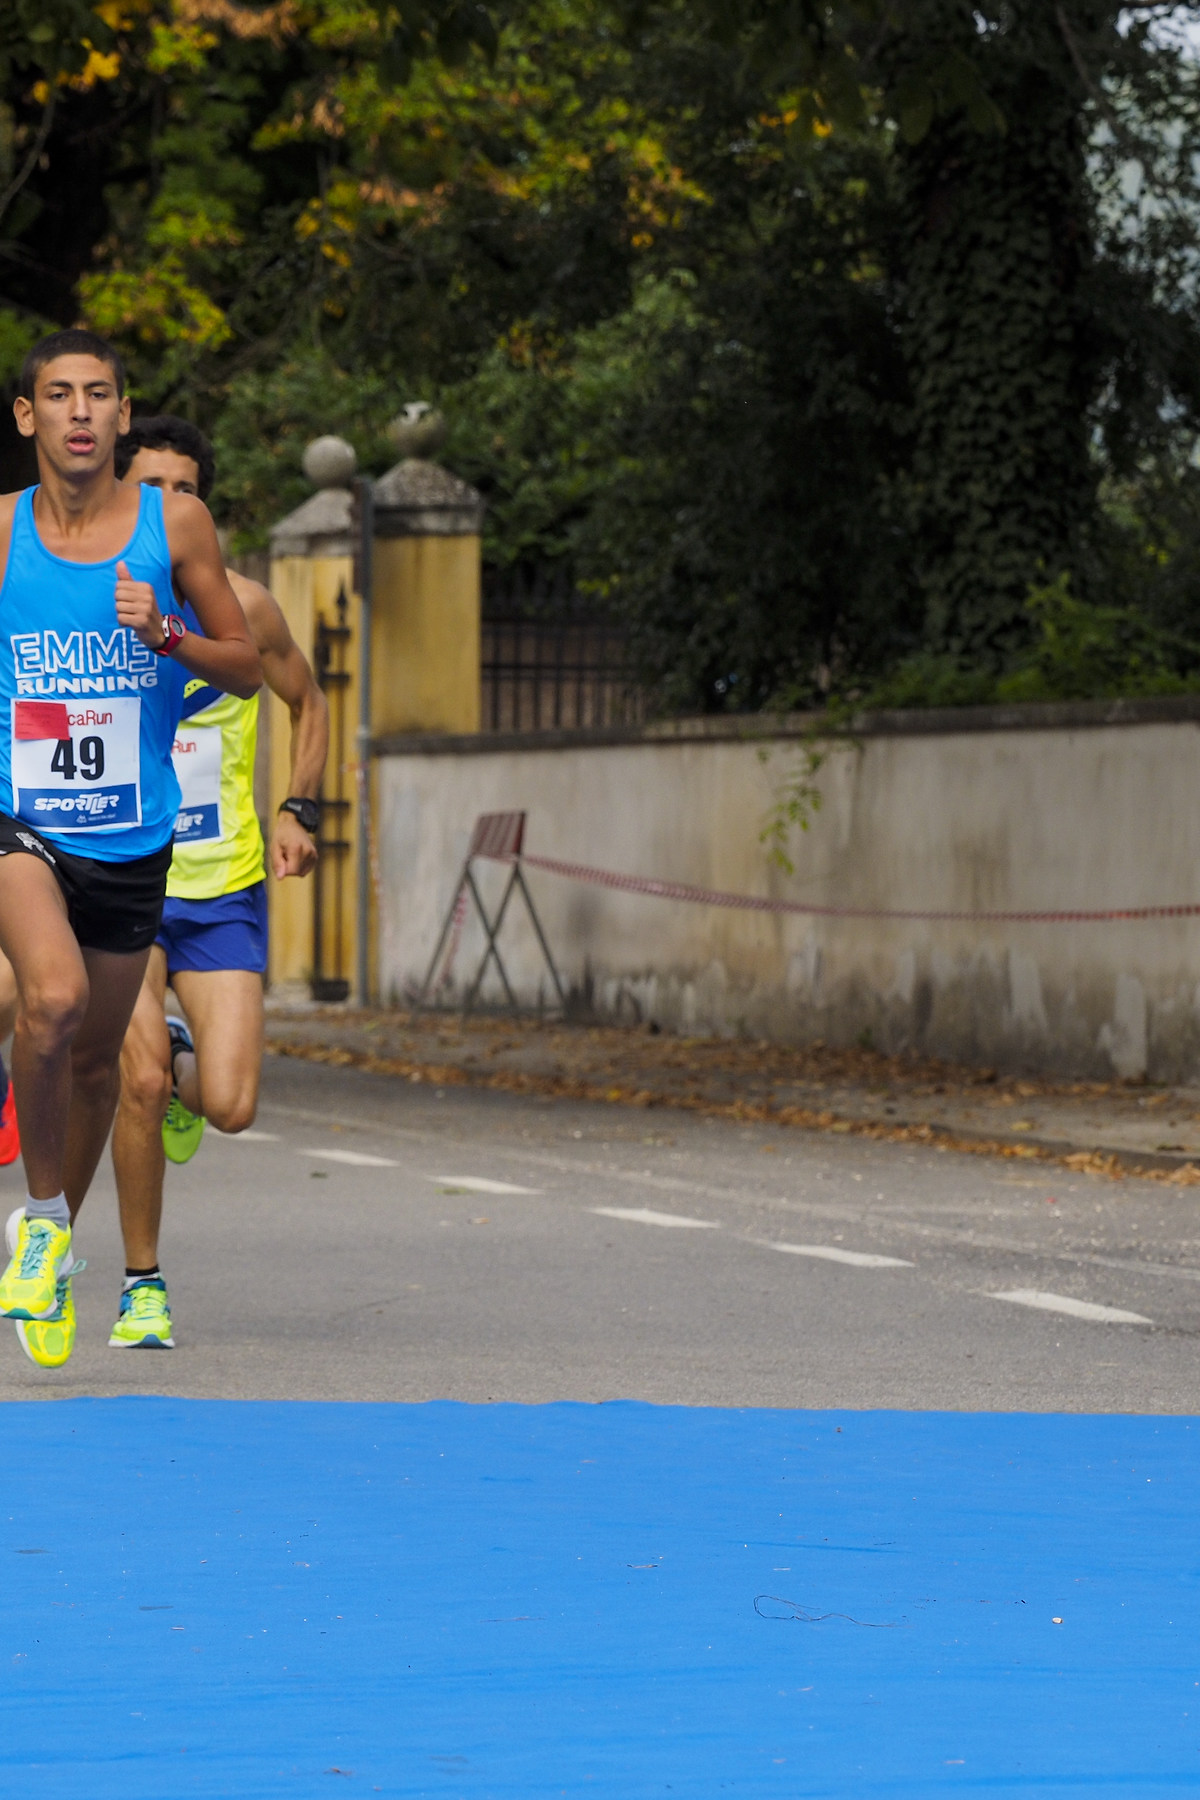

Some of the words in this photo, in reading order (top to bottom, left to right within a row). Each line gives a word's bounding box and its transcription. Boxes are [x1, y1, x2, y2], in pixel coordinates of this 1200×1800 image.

[16, 672, 158, 695] RUNNING
[50, 736, 105, 781] 49
[34, 792, 120, 815] SPORTLER
